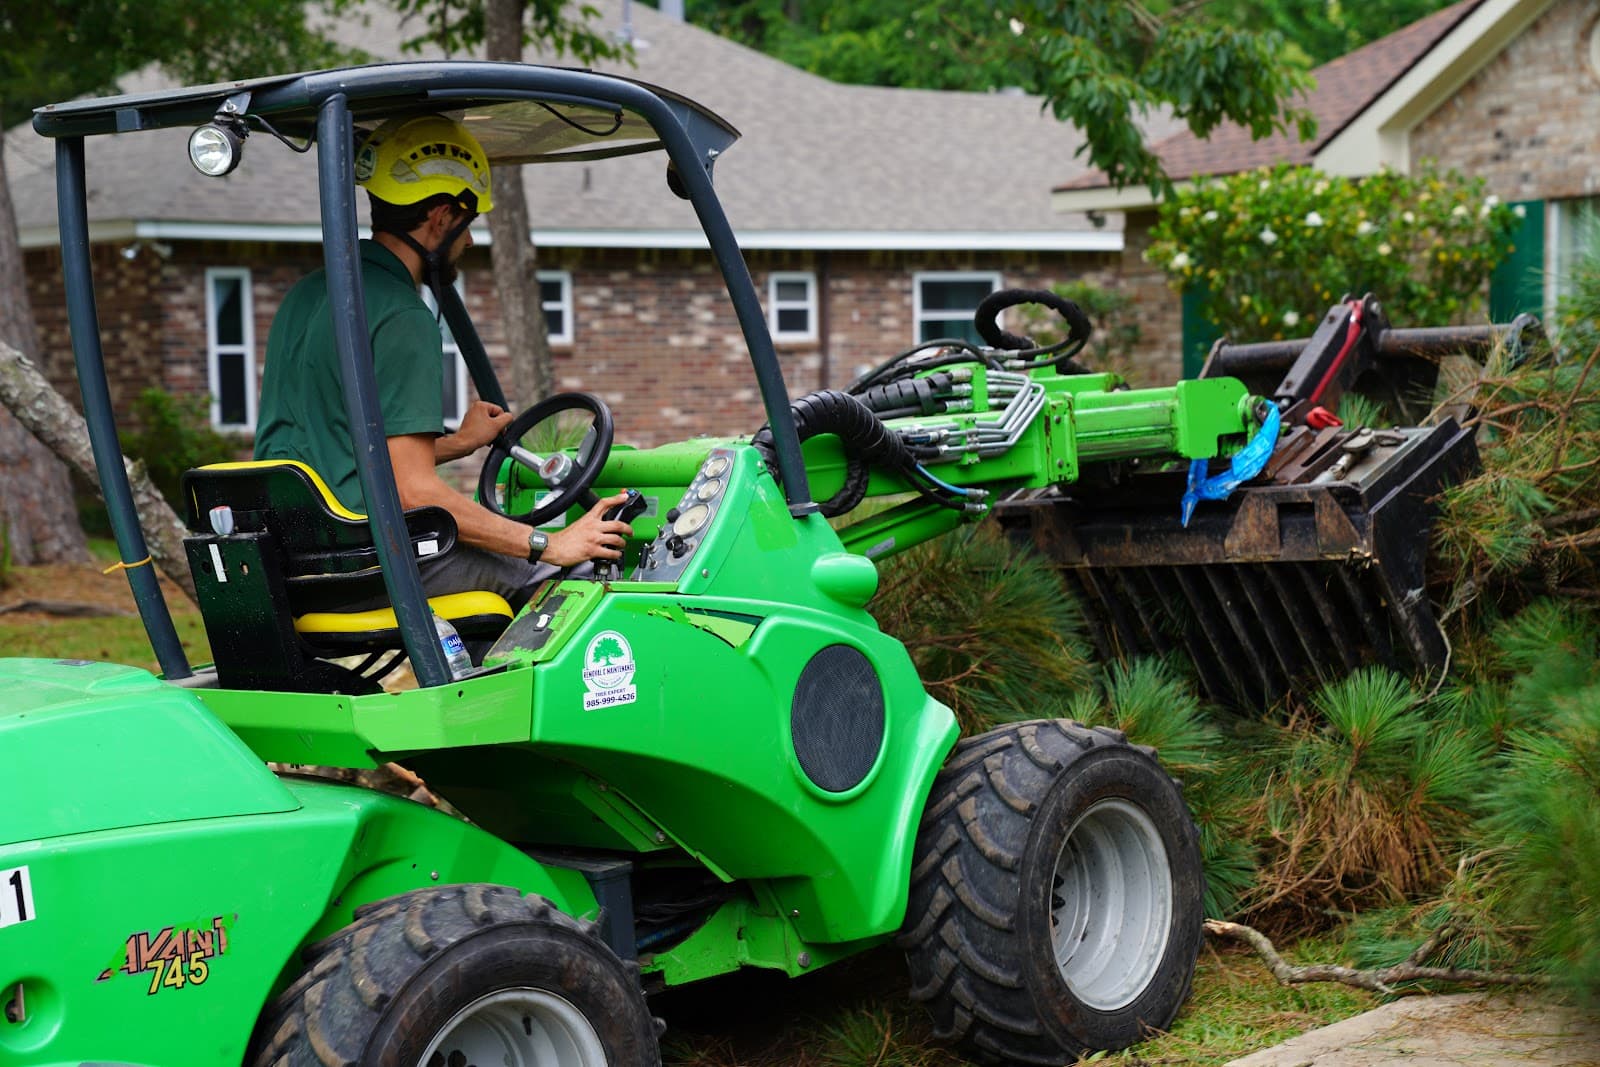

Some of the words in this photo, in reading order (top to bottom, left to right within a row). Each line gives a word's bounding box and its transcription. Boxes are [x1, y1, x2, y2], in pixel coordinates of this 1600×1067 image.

[586, 693, 635, 708] 985-999-4526
[608, 688, 626, 696] EXPERT
[0, 870, 27, 921] 1
[147, 950, 209, 995] 745
